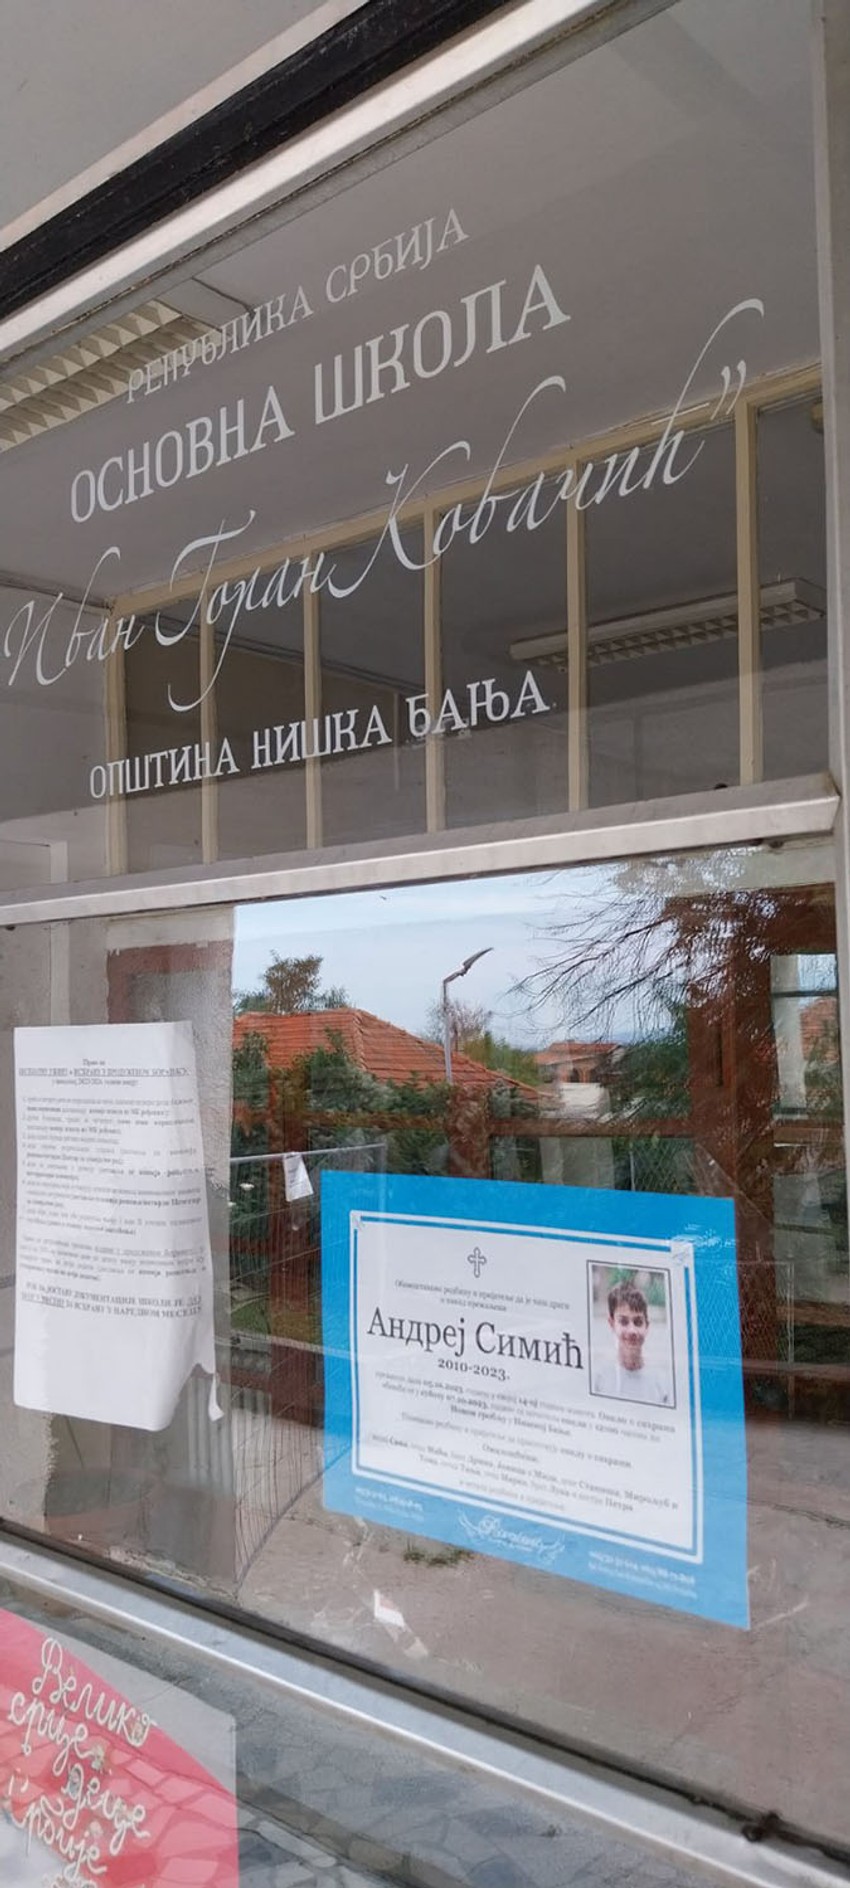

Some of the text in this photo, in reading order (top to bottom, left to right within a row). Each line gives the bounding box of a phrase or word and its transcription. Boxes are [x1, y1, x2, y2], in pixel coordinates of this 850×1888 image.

[126, 207, 469, 403] РЕПУБЛИКА СРБИЈА
[70, 264, 571, 523] ОСНОВНА ШКОЛА
[4, 546, 146, 686] Иван
[155, 510, 337, 712] Горан
[89, 669, 551, 799] ОПШТИНА НИШКА БАЊА
[366, 1306, 585, 1370] Андреј Симић
[437, 1357, 511, 1382] 2010-2023.
[32, 1637, 158, 1747] Велико
